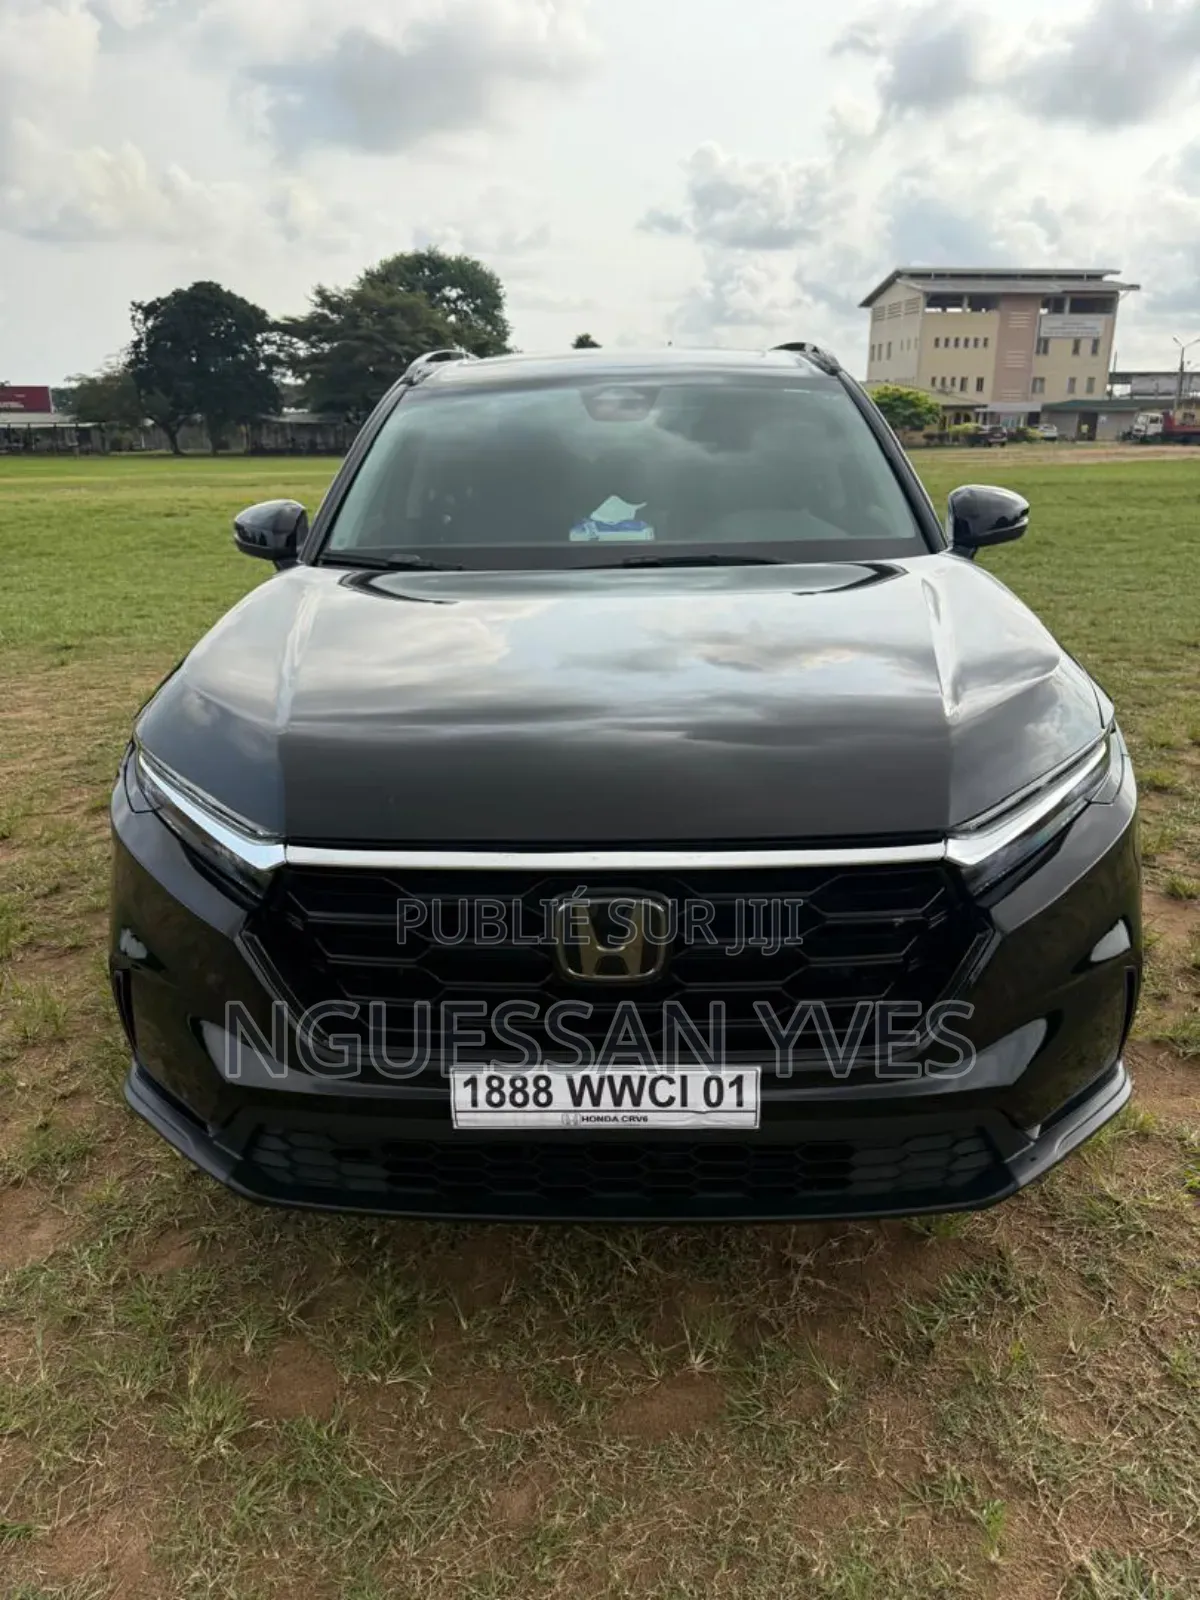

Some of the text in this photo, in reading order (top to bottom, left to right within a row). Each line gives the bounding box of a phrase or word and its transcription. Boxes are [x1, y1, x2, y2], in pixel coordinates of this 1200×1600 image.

[462, 1073, 745, 1109] 1888 WWCI 01
[581, 1115, 649, 1123] HONDA CRV6
